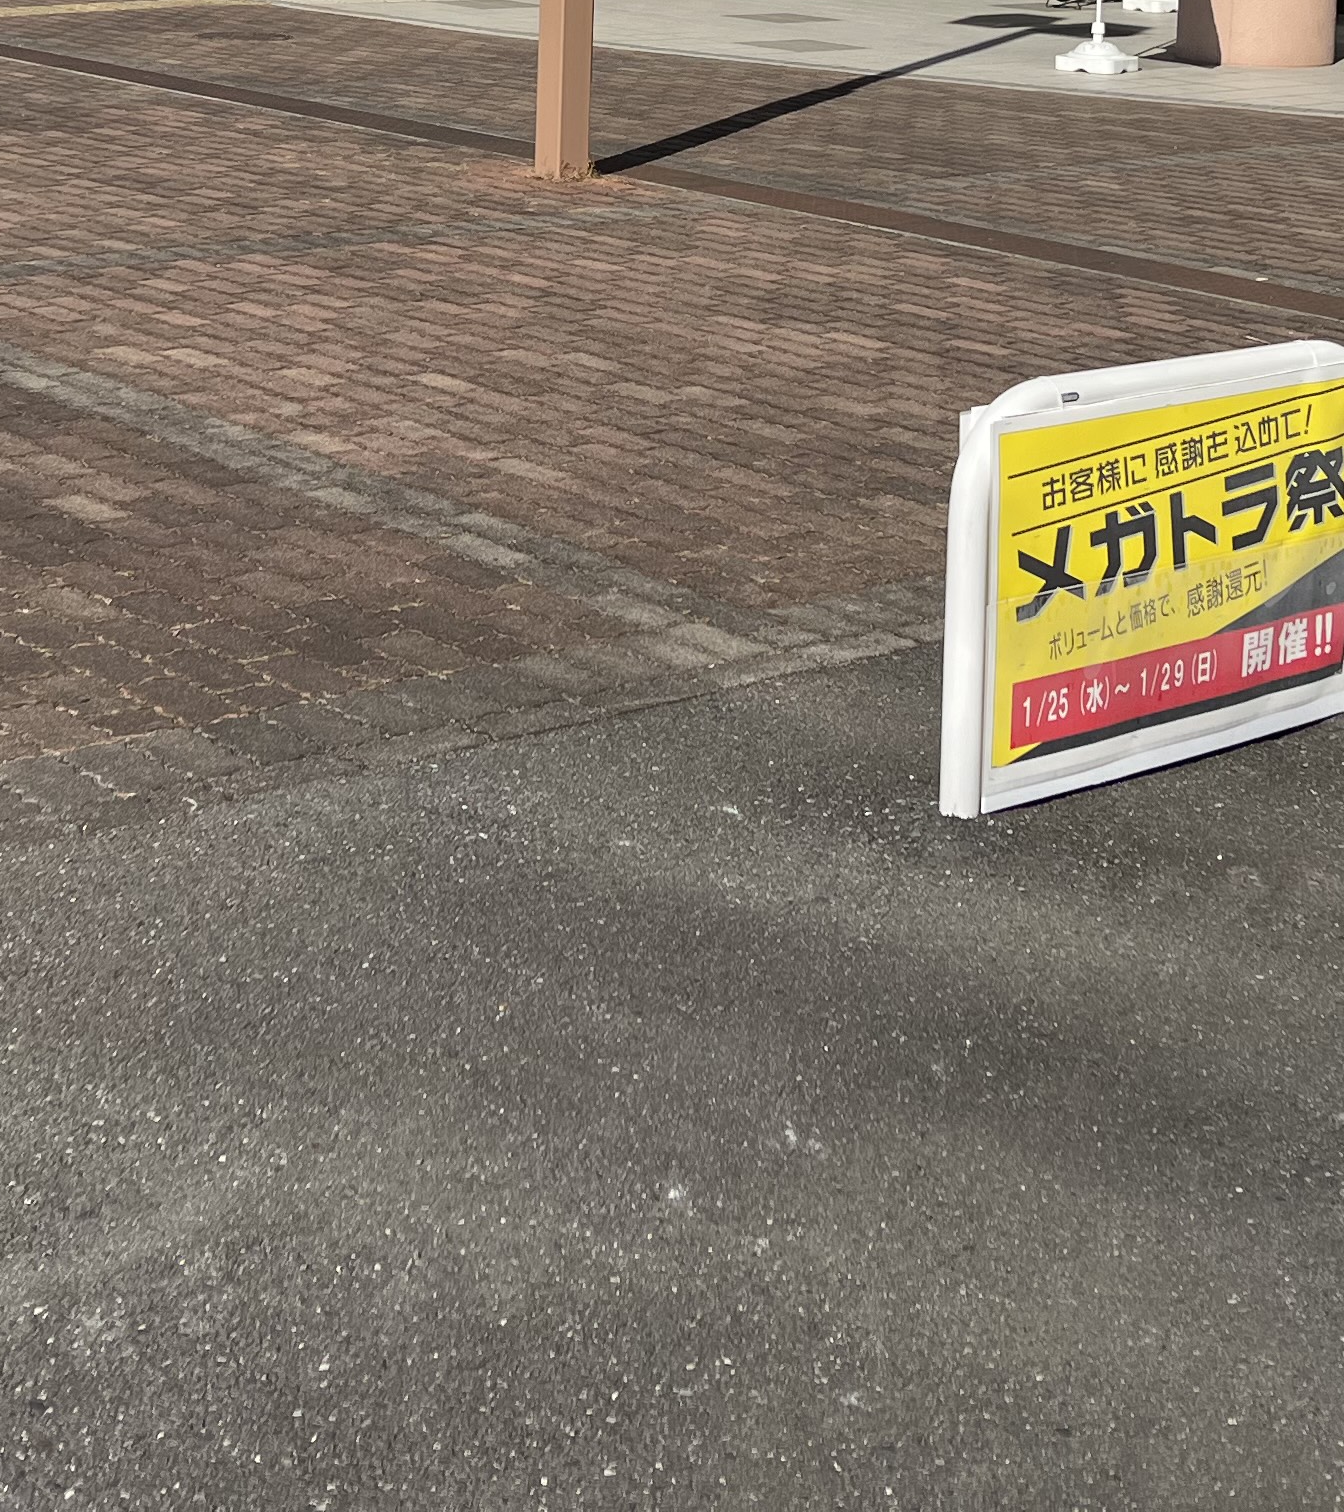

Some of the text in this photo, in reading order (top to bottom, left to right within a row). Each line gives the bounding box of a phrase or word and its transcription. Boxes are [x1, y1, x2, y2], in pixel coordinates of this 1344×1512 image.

[1042, 404, 1314, 511] お客様に感謝を込めて!
[1048, 559, 1269, 661] ボリュームと価格で、感謝還元!
[1241, 614, 1334, 678] 開催!!
